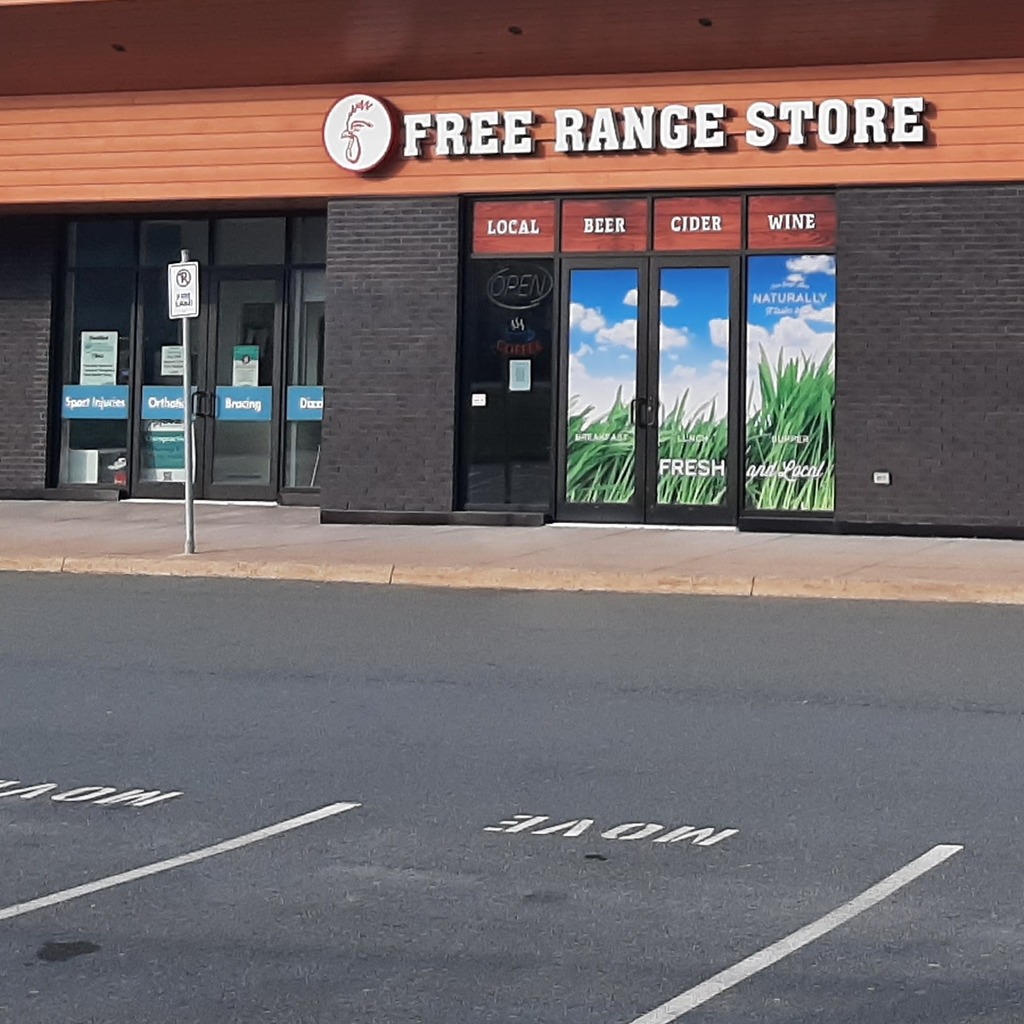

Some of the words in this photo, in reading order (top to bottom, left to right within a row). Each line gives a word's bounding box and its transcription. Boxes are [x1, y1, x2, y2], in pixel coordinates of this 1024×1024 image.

[403, 110, 535, 158] FREE
[554, 103, 728, 153] RANGE
[745, 96, 926, 148] STORE
[487, 219, 540, 236] LOCAL
[583, 217, 626, 234] BEER
[670, 215, 723, 233] CIDER
[767, 213, 816, 231] WINE
[491, 274, 547, 296] OPEN
[752, 292, 828, 304] NATURALLY
[65, 397, 90, 410] Sport
[92, 397, 126, 410] Injuries
[225, 397, 262, 412] Bracing
[659, 458, 726, 477] FRESH
[745, 461, 777, 477] and
[778, 460, 825, 482] Local
[483, 814, 740, 846] MOVE
